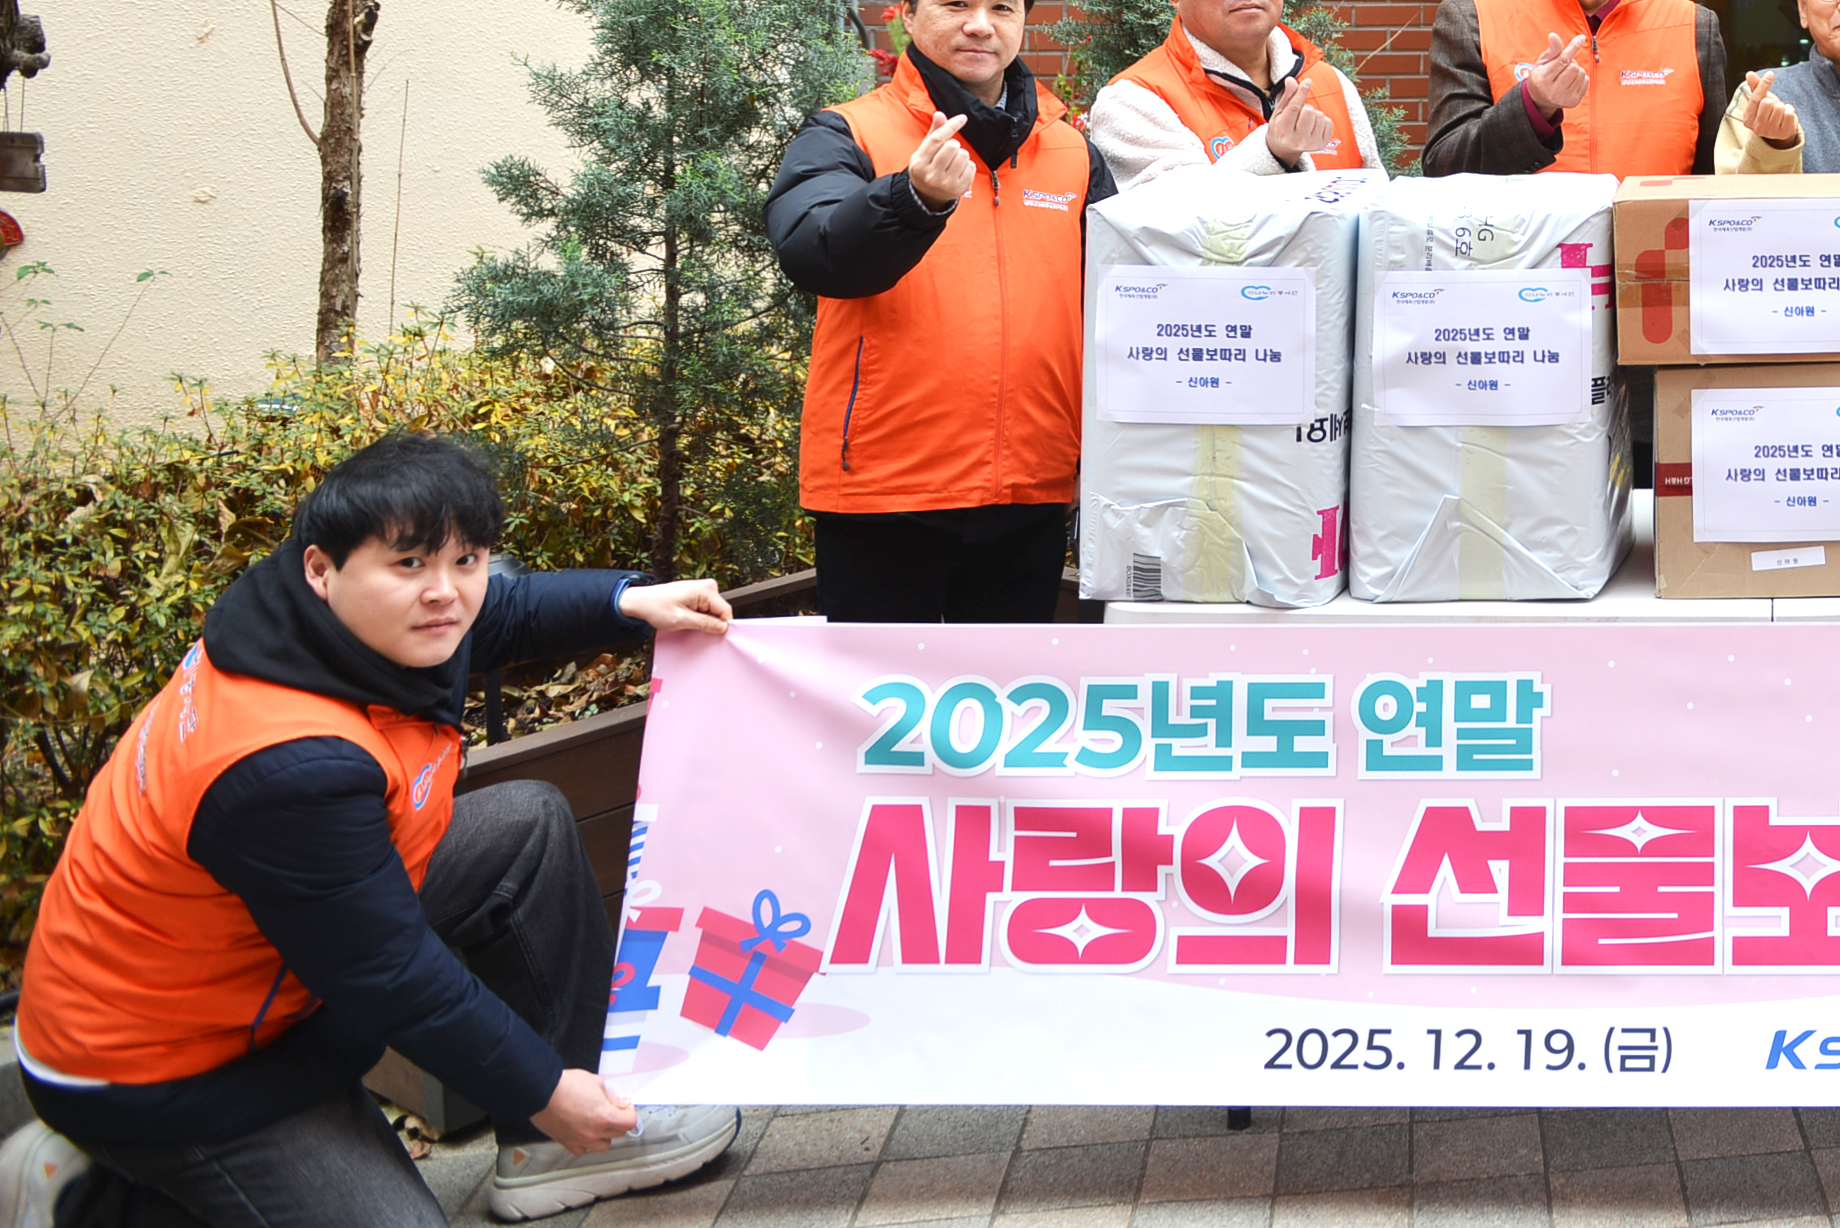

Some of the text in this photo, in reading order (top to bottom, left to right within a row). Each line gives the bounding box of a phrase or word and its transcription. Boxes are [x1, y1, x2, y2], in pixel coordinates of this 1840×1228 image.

[1752, 255, 1811, 268] 2025년도
[1115, 285, 1158, 293] KSPO&CO
[1724, 278, 1763, 292] 사랑의
[1773, 277, 1840, 290] 선물보따리
[1392, 291, 1435, 299] KSPO&CO
[1784, 306, 1815, 317] 신아원
[1156, 324, 1253, 338] 2025년도 연말
[1435, 327, 1530, 341] 2025년도 연말
[1127, 347, 1282, 363] 사랑의 선물보따리 나눔
[1406, 350, 1560, 365] 사랑의 선물보따리 나눔
[1188, 377, 1220, 387] 신아원
[1467, 380, 1498, 391] 신아원
[1754, 445, 1814, 458] 2025년도
[1725, 469, 1766, 482] 사랑의
[1786, 496, 1817, 507] 신아원
[856, 672, 1551, 781] 2025년도 연말
[826, 798, 1344, 976] 사랑의
[1262, 1027, 1674, 1075] 2025. 12. 19. (금)
